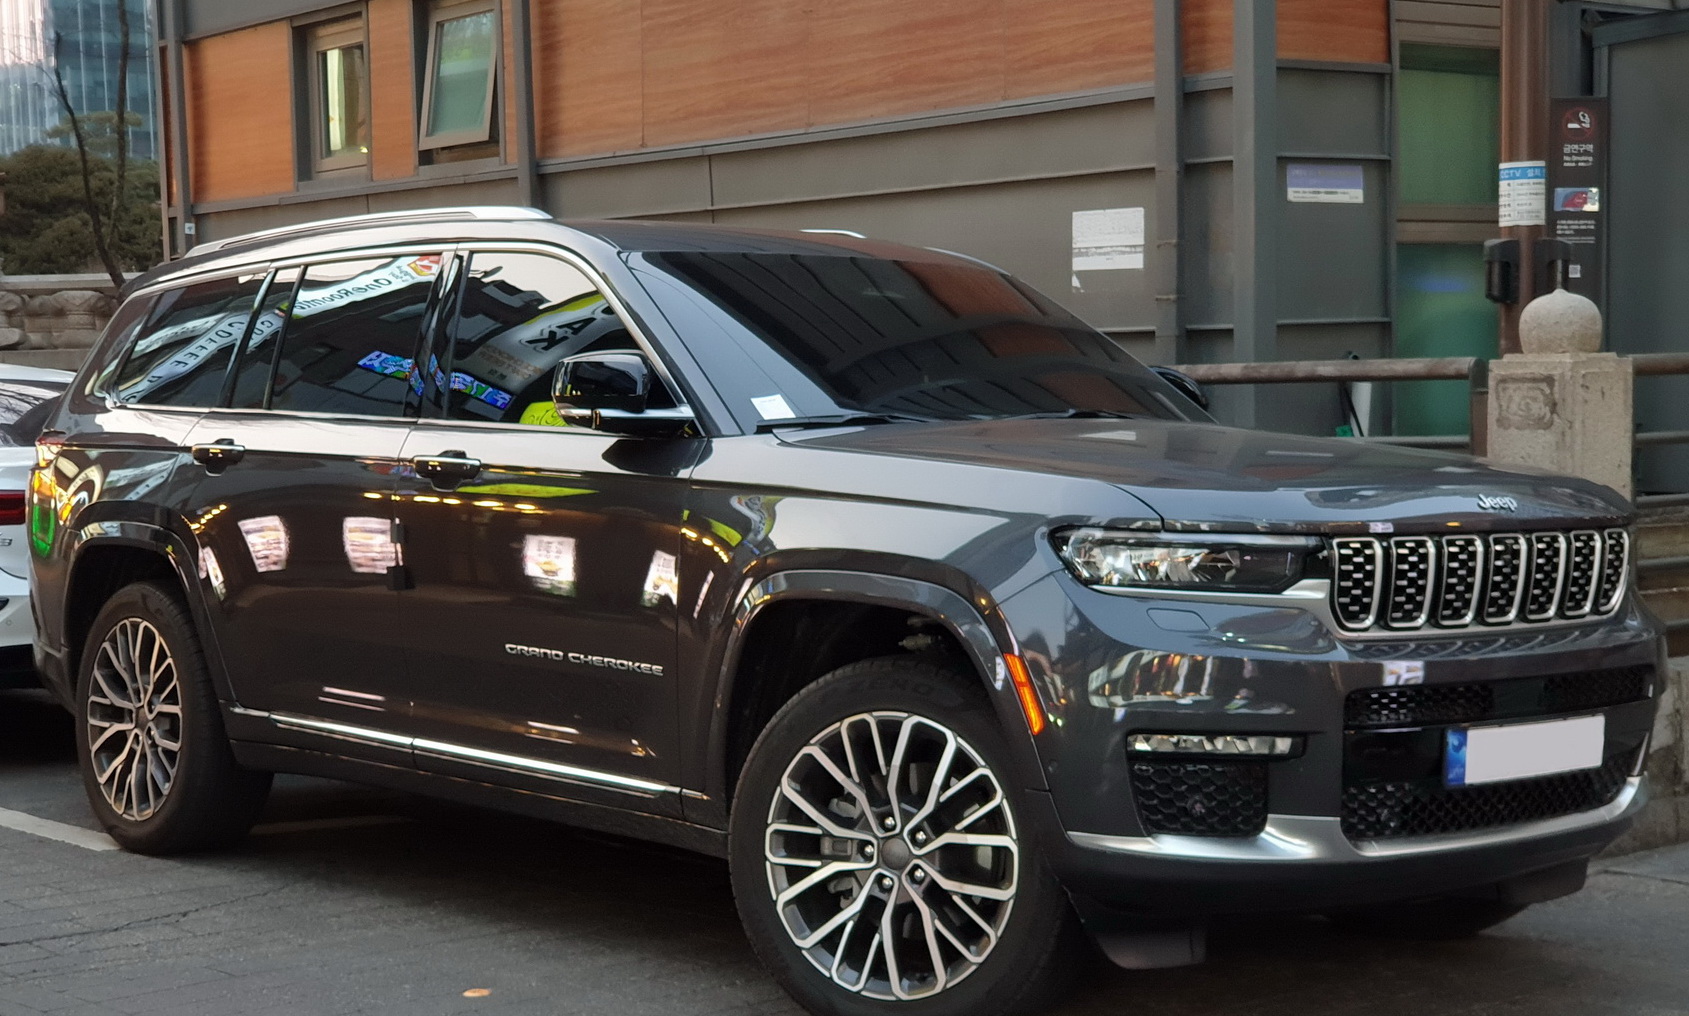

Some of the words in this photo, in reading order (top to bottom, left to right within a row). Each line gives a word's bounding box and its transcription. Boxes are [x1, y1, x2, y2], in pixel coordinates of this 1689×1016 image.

[1500, 169, 1521, 179] CCTV
[1477, 493, 1518, 512] Jeep
[504, 643, 564, 660] GRAND
[567, 652, 664, 677] CHEROKEE
